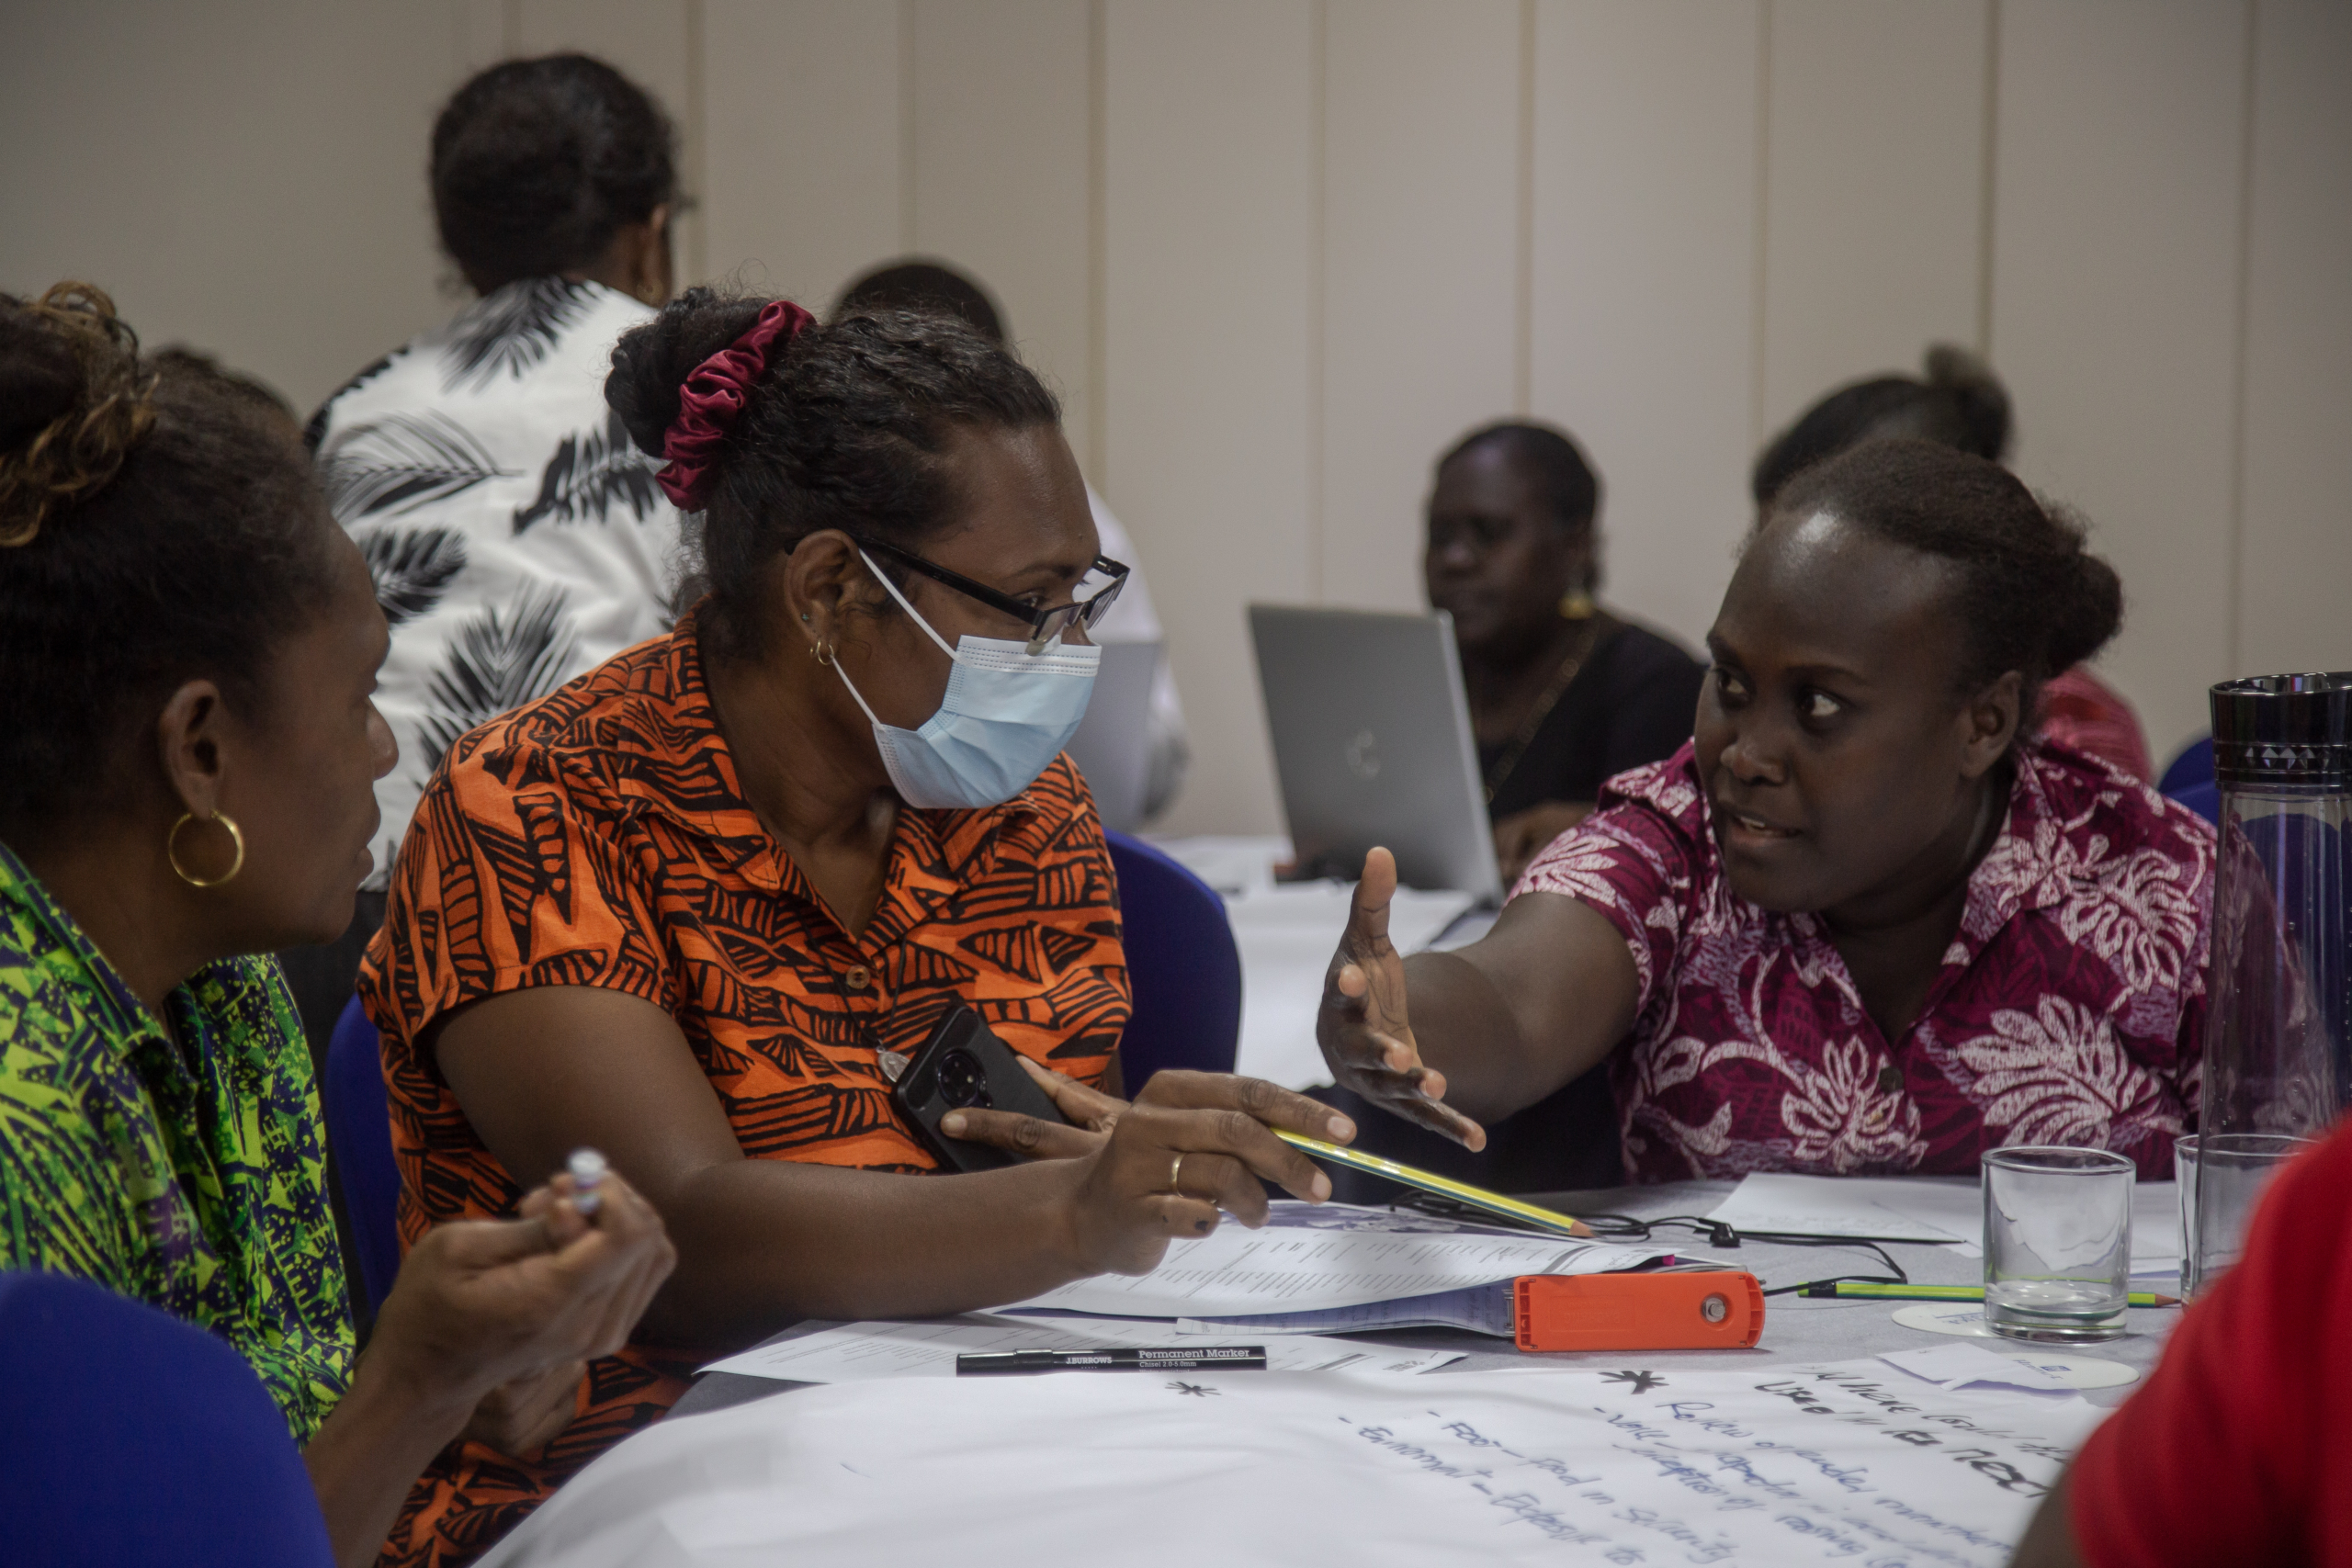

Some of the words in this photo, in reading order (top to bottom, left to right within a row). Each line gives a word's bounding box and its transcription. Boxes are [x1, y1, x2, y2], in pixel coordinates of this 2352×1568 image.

[1138, 1349, 1204, 1359] Permanent
[1206, 1348, 1250, 1358] Marker
[1065, 1357, 1113, 1365] J.BURROWS
[1655, 1401, 1755, 1438] Review
